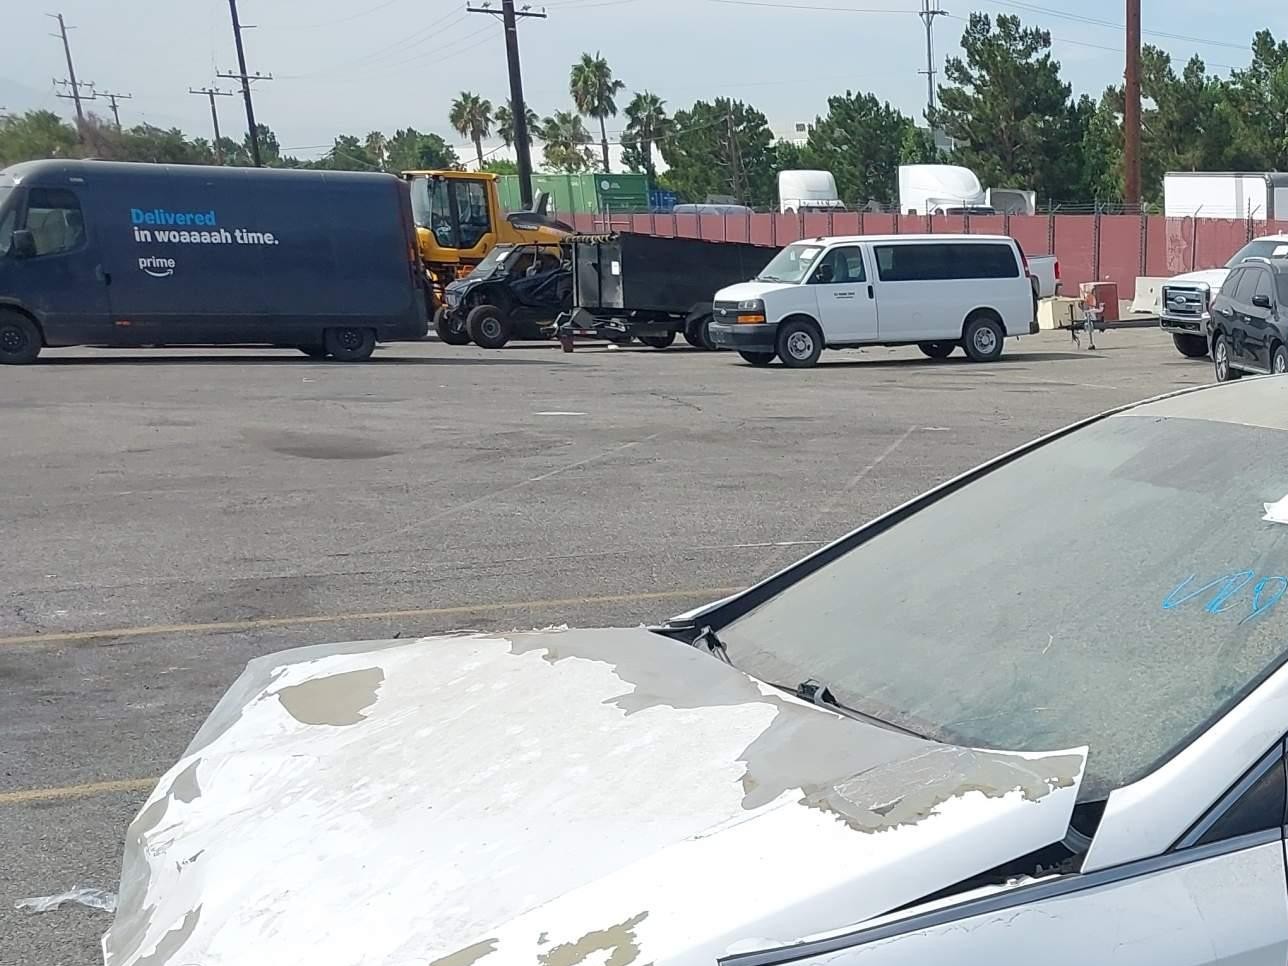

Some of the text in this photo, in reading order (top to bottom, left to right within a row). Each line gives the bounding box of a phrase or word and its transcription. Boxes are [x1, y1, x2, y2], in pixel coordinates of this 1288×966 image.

[131, 208, 216, 226] Delivered
[133, 226, 280, 245] in woaaaah time.
[138, 256, 175, 269] prime
